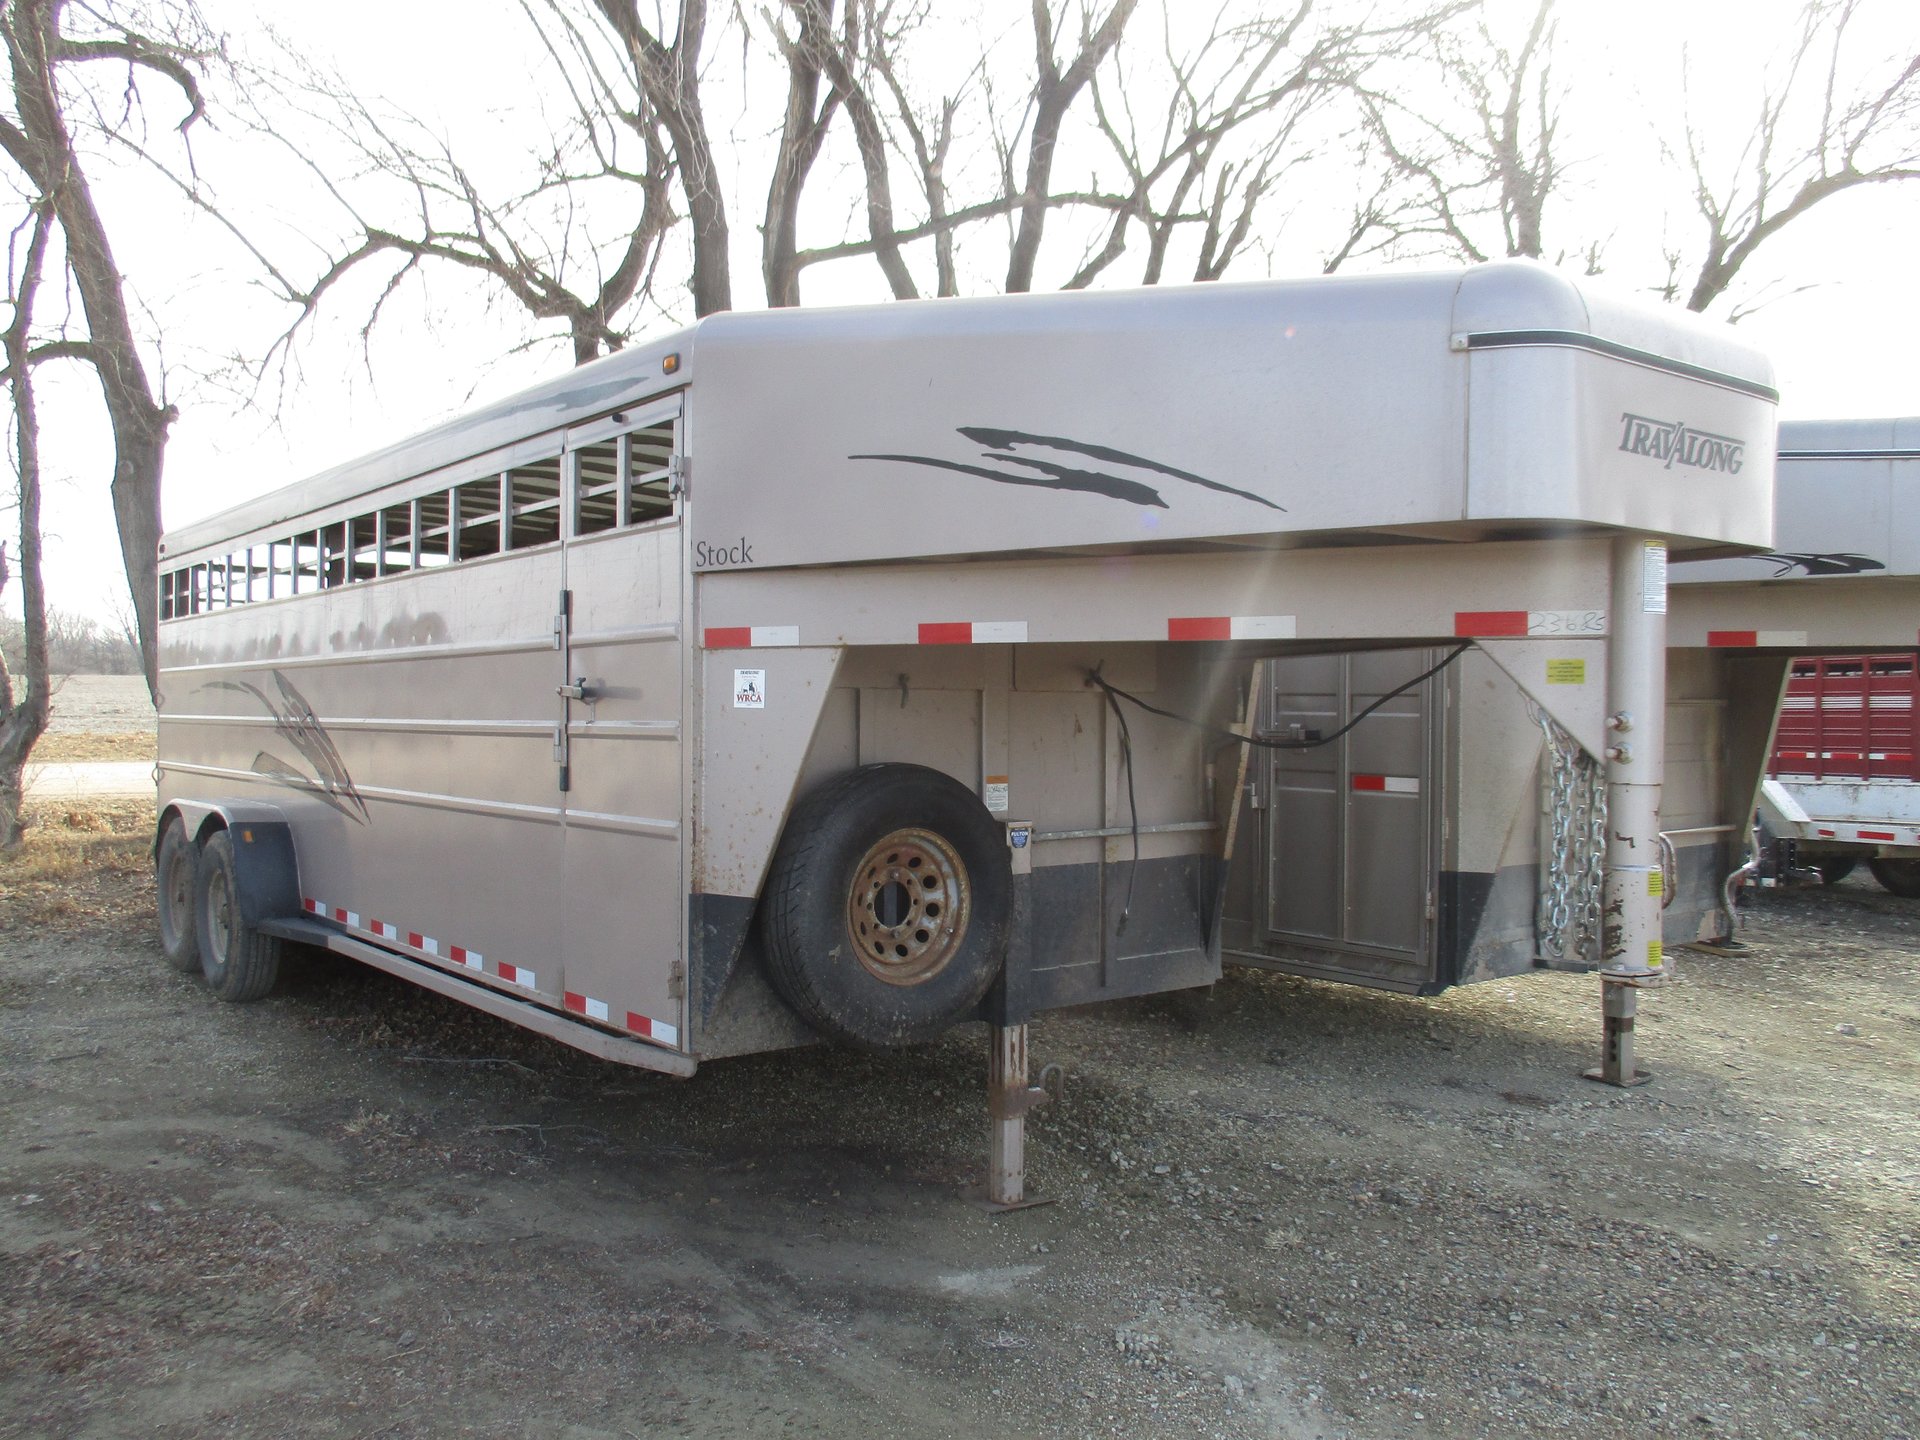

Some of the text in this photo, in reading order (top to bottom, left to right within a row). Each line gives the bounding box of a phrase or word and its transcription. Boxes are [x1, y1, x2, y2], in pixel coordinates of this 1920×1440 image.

[1618, 412, 1745, 475] TRAVALONG
[696, 536, 753, 567] Stock
[737, 694, 762, 702] WRCA
